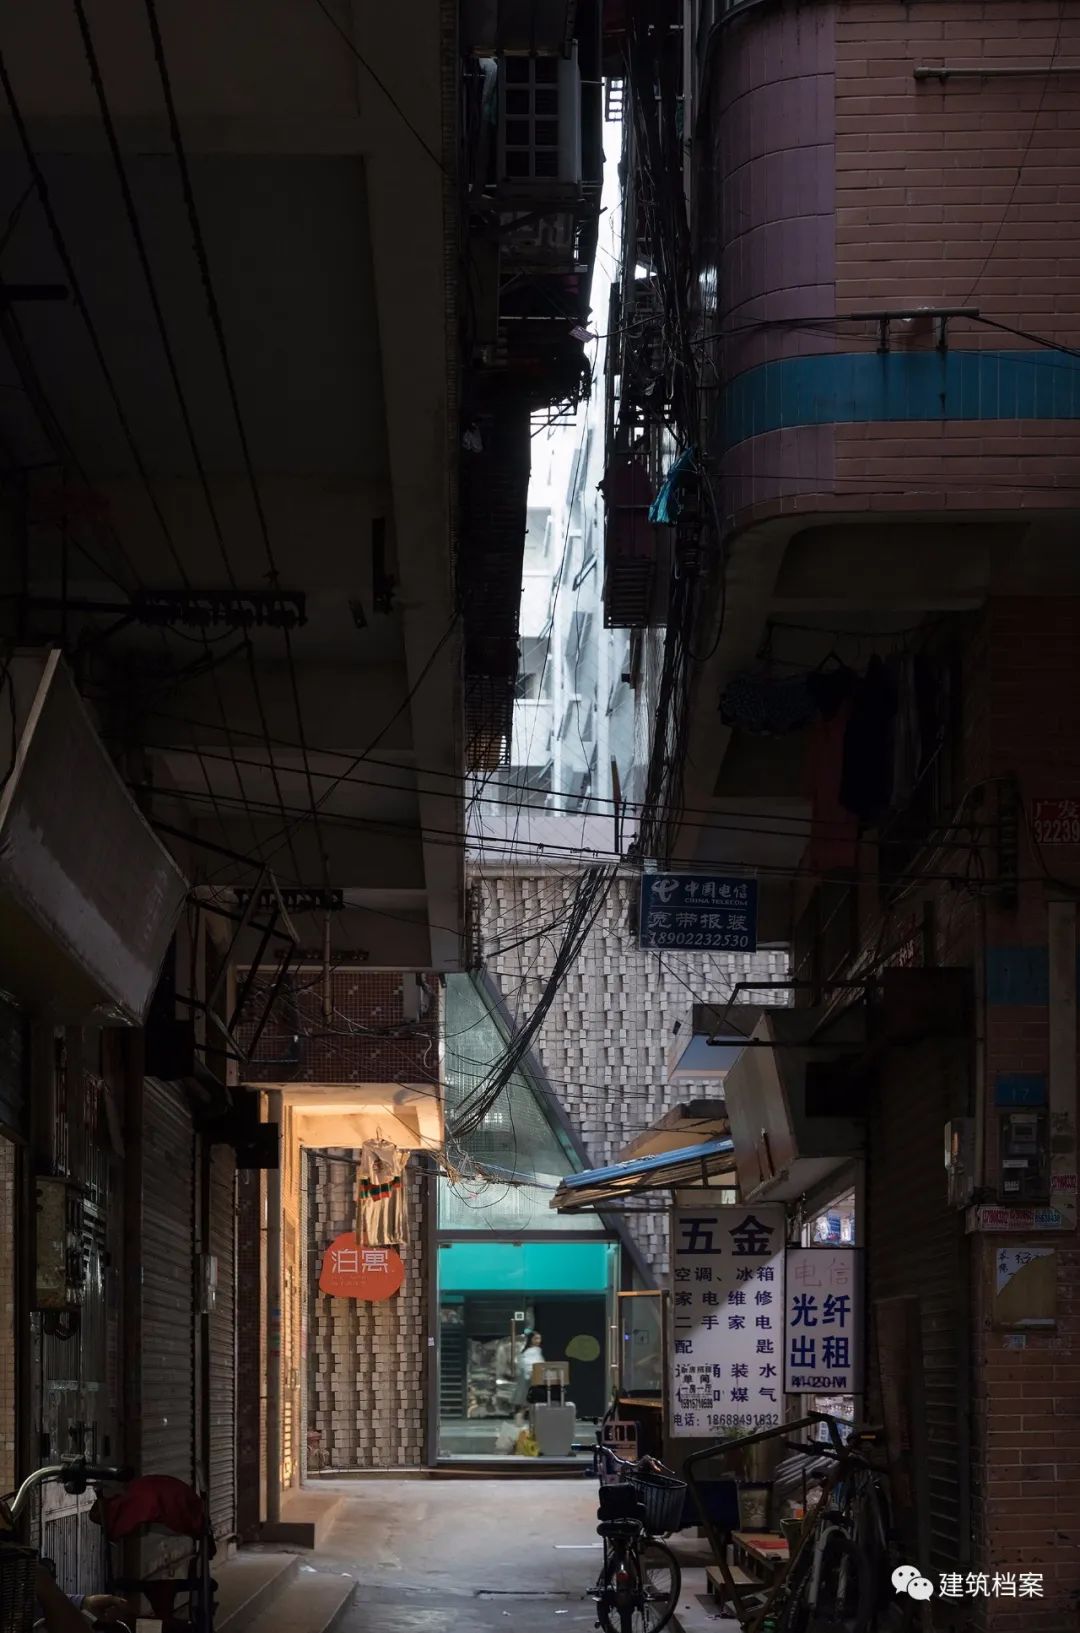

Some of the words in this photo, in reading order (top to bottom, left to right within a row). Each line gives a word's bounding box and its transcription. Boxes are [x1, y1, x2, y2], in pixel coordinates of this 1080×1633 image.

[684, 880, 748, 899] 中国电信
[648, 912, 748, 931] 宽带报装
[677, 1215, 774, 1255] 五金
[331, 1248, 388, 1273] 泊寓
[794, 1259, 850, 1288] 电信
[675, 1290, 773, 1306] 家电维修
[790, 1293, 851, 1327] 光纤
[675, 1315, 772, 1330] 二手家电
[790, 1335, 851, 1369] 出租
